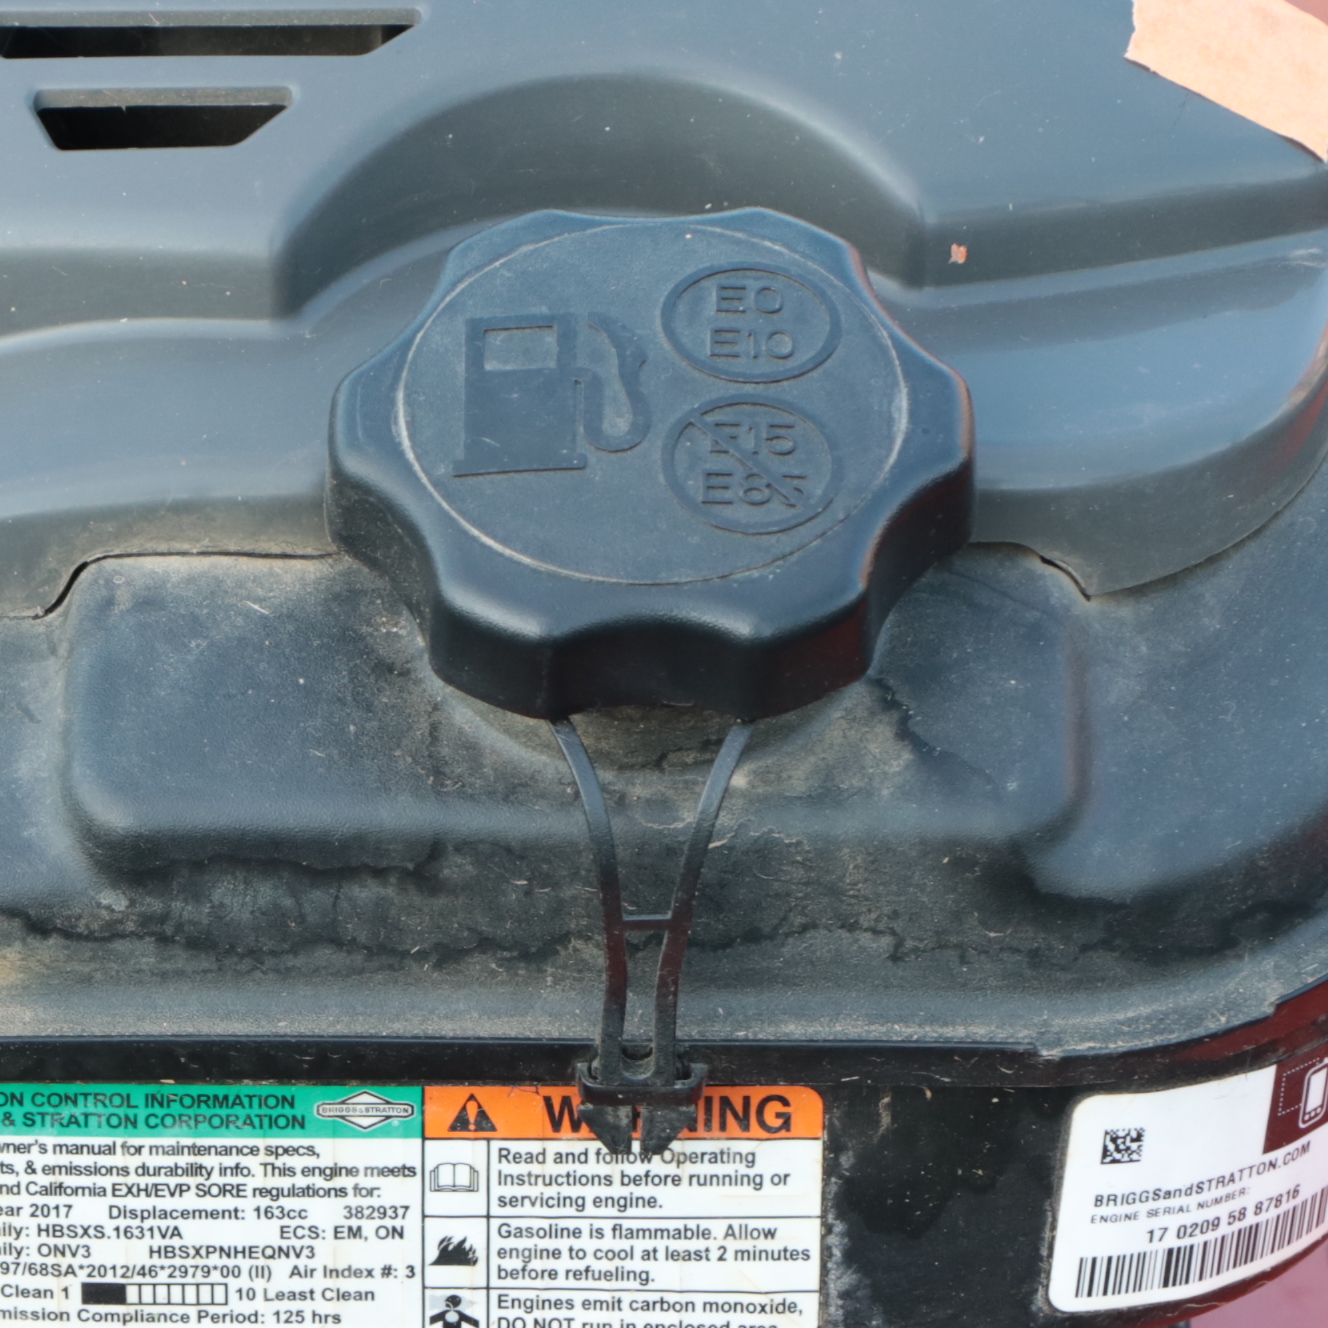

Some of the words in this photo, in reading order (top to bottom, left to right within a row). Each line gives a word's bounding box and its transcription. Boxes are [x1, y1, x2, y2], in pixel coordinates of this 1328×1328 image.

[31, 1092, 138, 1108] CONTROL
[144, 1093, 295, 1109] INFORMATION
[2, 1112, 16, 1127] &
[23, 1113, 137, 1129] STRATTON
[144, 1114, 305, 1130] CORPORATION
[53, 1141, 116, 1156] manual
[120, 1142, 144, 1156] for
[149, 1142, 260, 1157] maintenance
[264, 1144, 320, 1160] specs,
[497, 1148, 546, 1164] Read
[554, 1149, 588, 1165] and
[660, 1150, 756, 1168] Operating
[24, 1161, 37, 1175] &
[42, 1163, 130, 1176] emissions
[136, 1162, 213, 1180] durability
[219, 1164, 255, 1177] info.
[260, 1163, 296, 1177] This
[301, 1164, 359, 1181] engine
[364, 1164, 416, 1177] meets
[497, 1170, 613, 1187] Instructions
[621, 1171, 681, 1187] before
[689, 1171, 763, 1190] running
[771, 1174, 790, 1186] or
[1094, 1140, 1311, 1207] BRIGGSandSTRATTON.COM
[26, 1182, 106, 1197] California
[111, 1183, 191, 1198] EXH/EVP
[196, 1184, 247, 1198] SORE
[253, 1185, 347, 1201] regulations
[353, 1185, 381, 1198] for:
[497, 1193, 586, 1212] servicing
[593, 1193, 663, 1212] engine.
[1090, 1210, 1140, 1224] ENGINE
[1146, 1205, 1192, 1219] SERIAL
[1197, 1186, 1250, 1210] NUMBER:
[29, 1204, 73, 1218] 2017
[108, 1206, 246, 1222] Displacement:
[253, 1206, 308, 1220] 163cc
[343, 1206, 410, 1220] 382937
[1147, 1227, 1168, 1243] 17
[1176, 1216, 1220, 1239] 0209
[1227, 1206, 1247, 1226] 58
[1254, 1184, 1301, 1216] 87816
[37, 1223, 183, 1240] HBSXS.1631VA
[280, 1226, 326, 1240] ECS:
[334, 1226, 368, 1241] EM,
[375, 1226, 404, 1240] ON
[497, 1223, 582, 1240] Gasoline
[589, 1224, 605, 1240] is
[612, 1224, 717, 1241] flammable.
[724, 1225, 778, 1241] Allow
[497, 1246, 562, 1264] engine
[569, 1246, 586, 1260] to
[593, 1246, 634, 1261] cool
[641, 1246, 658, 1261] at
[665, 1246, 711, 1261] least
[717, 1246, 727, 1262] 2
[734, 1246, 811, 1262] minutes
[289, 1265, 317, 1278] Air
[323, 1265, 375, 1279] Index
[380, 1265, 398, 1279] #:
[405, 1265, 415, 1279] 3
[497, 1265, 558, 1281] before
[565, 1266, 655, 1286] refueling.
[1, 1284, 54, 1299] Clean
[61, 1287, 69, 1300] 1
[235, 1288, 256, 1301] 10
[264, 1288, 314, 1301] Least
[322, 1288, 375, 1302] Clean
[497, 1294, 574, 1313] Engines
[582, 1296, 622, 1312] emit
[629, 1296, 695, 1313] carbon
[703, 1298, 803, 1316] monoxide,
[77, 1308, 190, 1325] Compliance
[198, 1311, 265, 1324] Period:
[273, 1311, 305, 1324] 125
[312, 1311, 341, 1324] hrs
